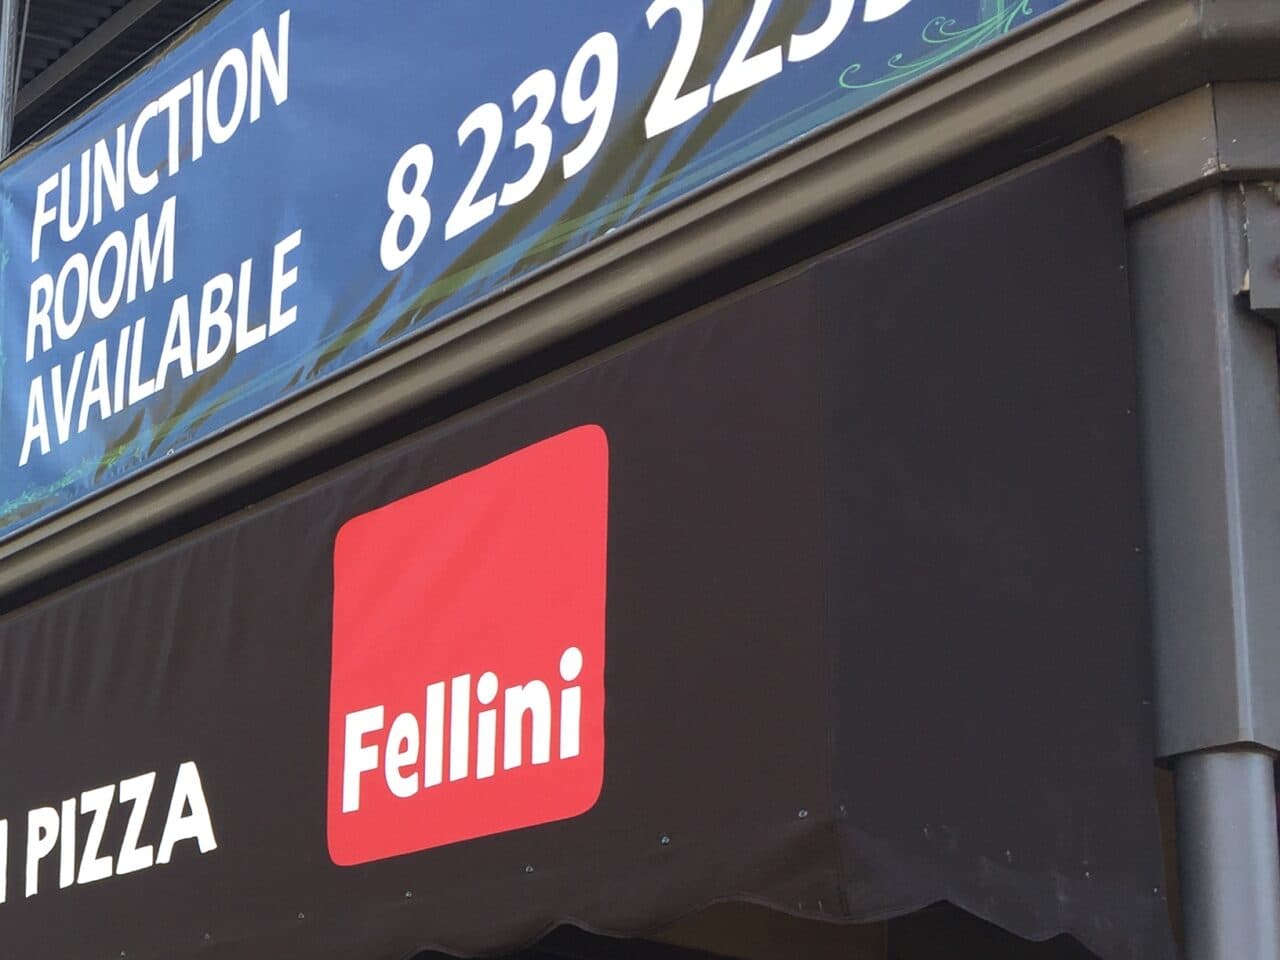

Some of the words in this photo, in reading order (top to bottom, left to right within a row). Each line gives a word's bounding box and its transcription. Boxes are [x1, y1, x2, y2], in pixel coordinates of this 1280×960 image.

[31, 9, 291, 263] FUNCTION
[380, 142, 434, 271] 8
[445, 31, 619, 241] 239
[645, 0, 913, 139] 22
[18, 229, 302, 467] AVAILABLE
[24, 195, 176, 363] ROOM
[25, 761, 218, 898] PIZZA
[342, 646, 583, 813] Fellini
